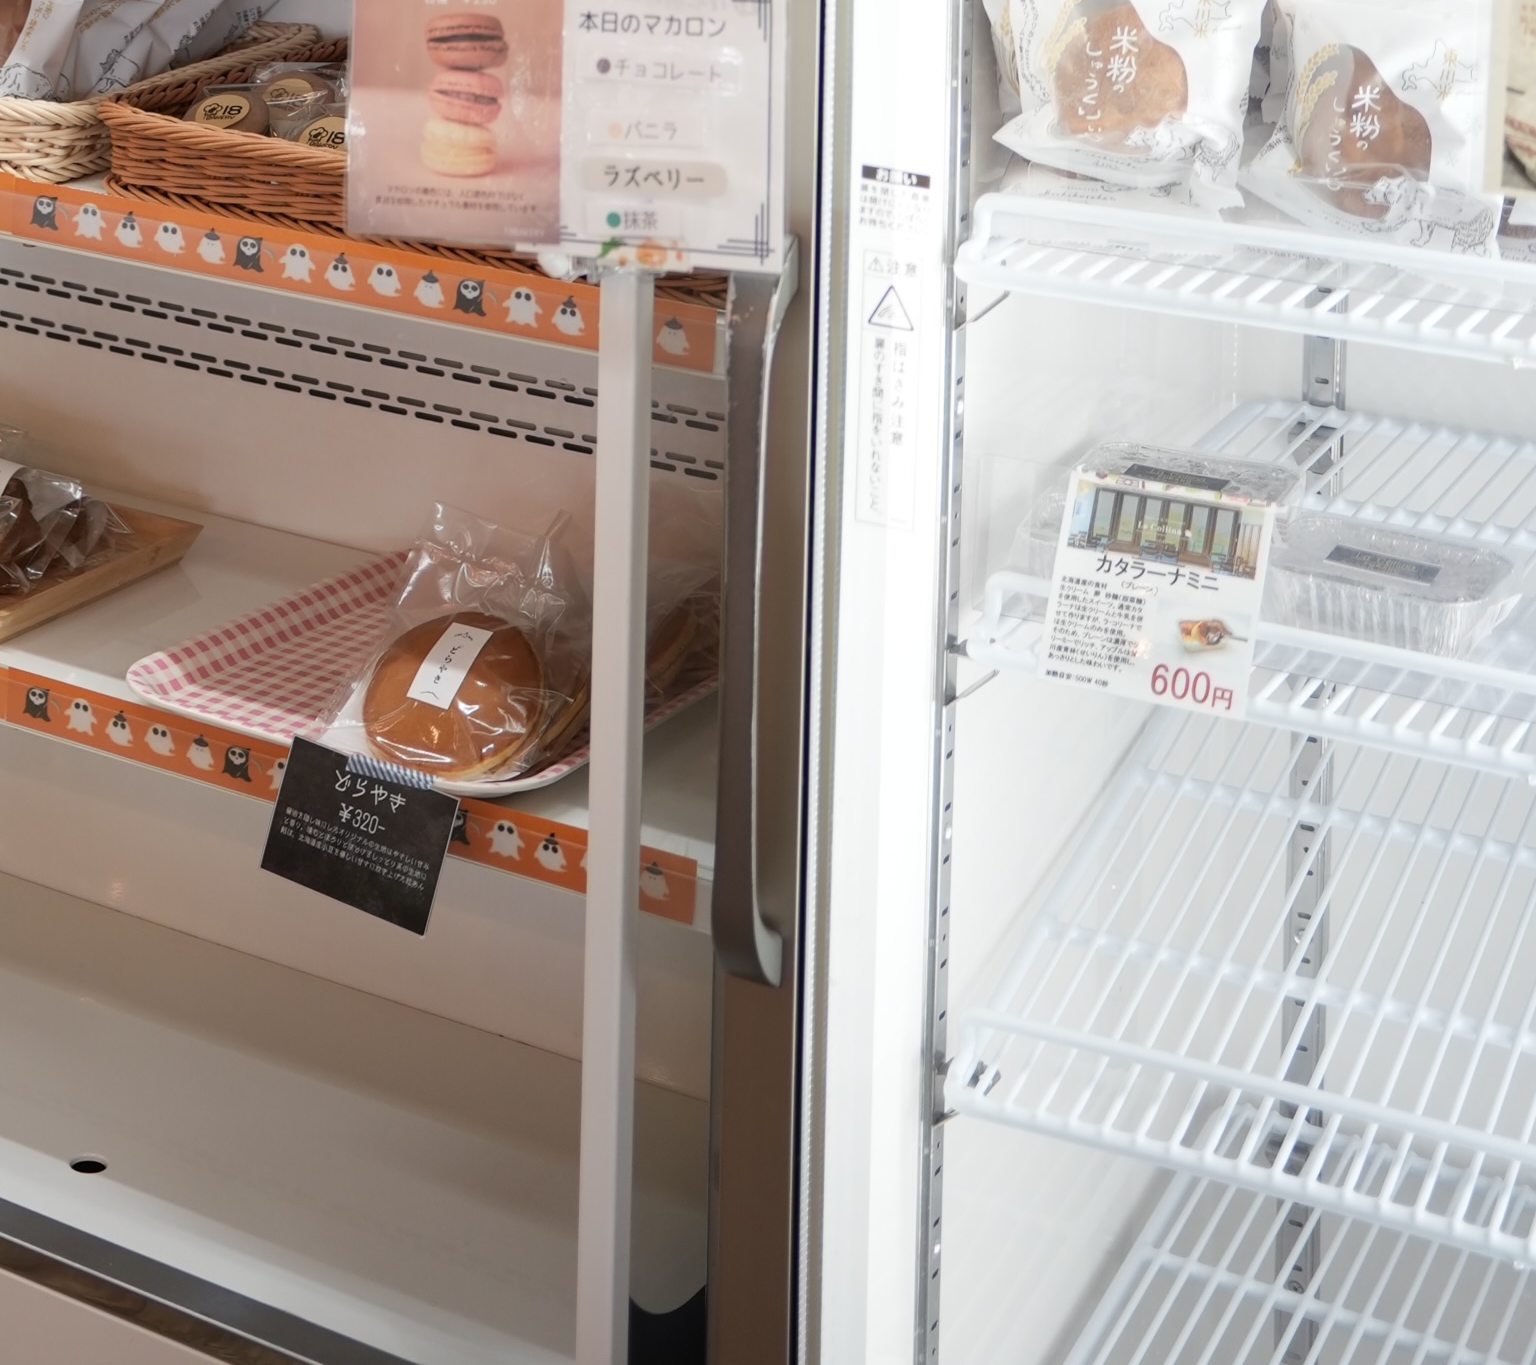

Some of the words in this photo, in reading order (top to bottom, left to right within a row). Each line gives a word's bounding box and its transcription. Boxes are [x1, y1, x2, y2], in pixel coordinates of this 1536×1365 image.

[578, 10, 728, 37] 本日のマカロン
[613, 59, 723, 83] チョコレート
[1106, 26, 1139, 94] 米粉の
[1436, 48, 1458, 100] 東川米
[622, 120, 678, 141] バニラ
[1350, 85, 1382, 152] 米粉の
[603, 167, 706, 192] ラズベリー
[622, 208, 659, 231] 抹茶
[1061, 576, 1108, 589] 北海道産の食材
[1096, 555, 1219, 591] カタラーナミニ
[1150, 663, 1233, 710] 600円
[334, 770, 407, 813] どらやき
